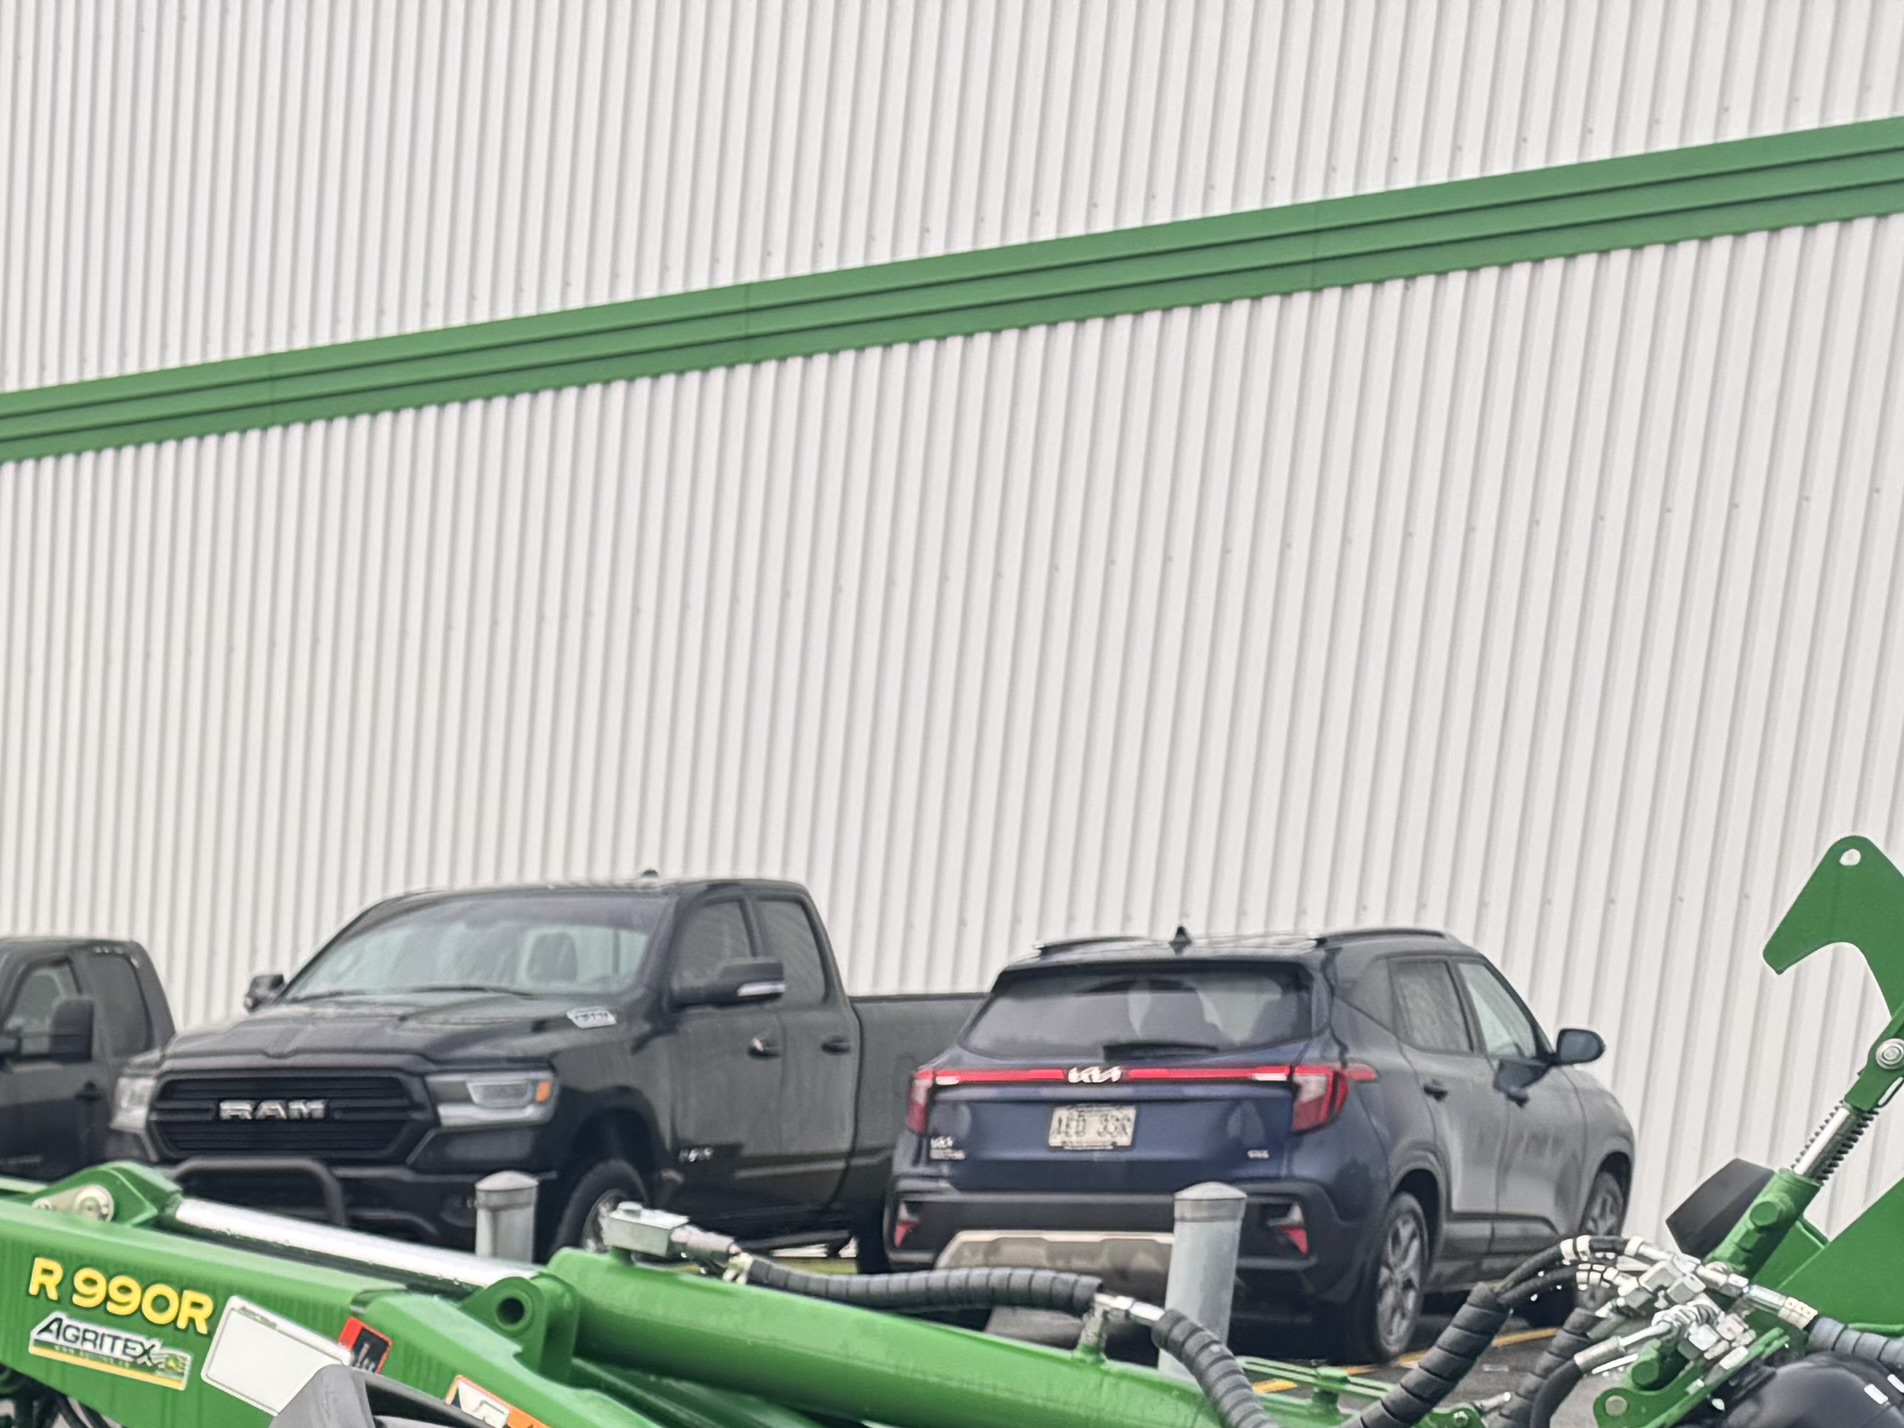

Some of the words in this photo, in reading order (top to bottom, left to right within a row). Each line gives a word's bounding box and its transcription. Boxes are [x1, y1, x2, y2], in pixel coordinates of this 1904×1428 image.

[219, 1100, 325, 1120] RAM
[28, 1256, 64, 1301] R
[72, 1267, 214, 1335] 990R
[37, 1317, 158, 1366] AGRITEX
